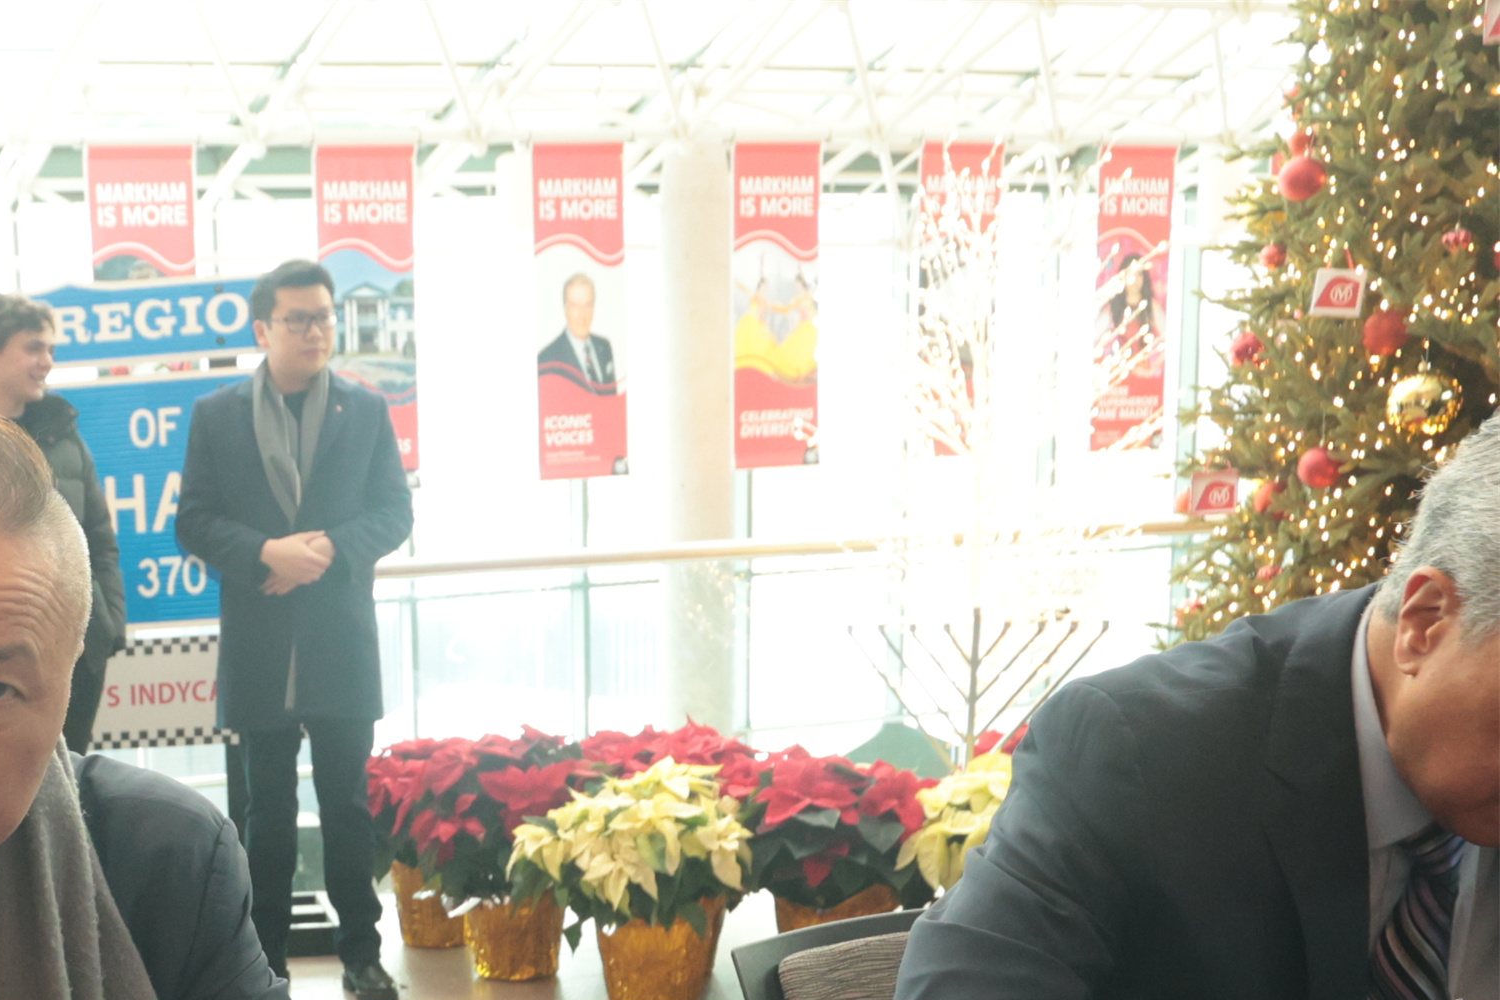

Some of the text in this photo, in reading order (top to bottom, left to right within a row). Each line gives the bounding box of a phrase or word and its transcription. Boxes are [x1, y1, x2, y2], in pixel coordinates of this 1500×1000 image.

[95, 182, 187, 204] MARKHAM
[323, 180, 408, 201] MARKHAM
[538, 177, 619, 198] MARKHAM
[740, 175, 815, 195] MARKHAM
[97, 203, 189, 228] IS MORE
[324, 202, 408, 224] IS MORE
[539, 198, 618, 222] IS MORE
[739, 195, 815, 218] IS MORE
[1103, 195, 1169, 217] IS MORE
[53, 292, 250, 345] REGIO
[129, 406, 183, 449] OF
[544, 413, 593, 430] ICONIC
[740, 421, 797, 439] DIVERSIT
[545, 429, 595, 447] VOICES
[137, 554, 208, 599] 370
